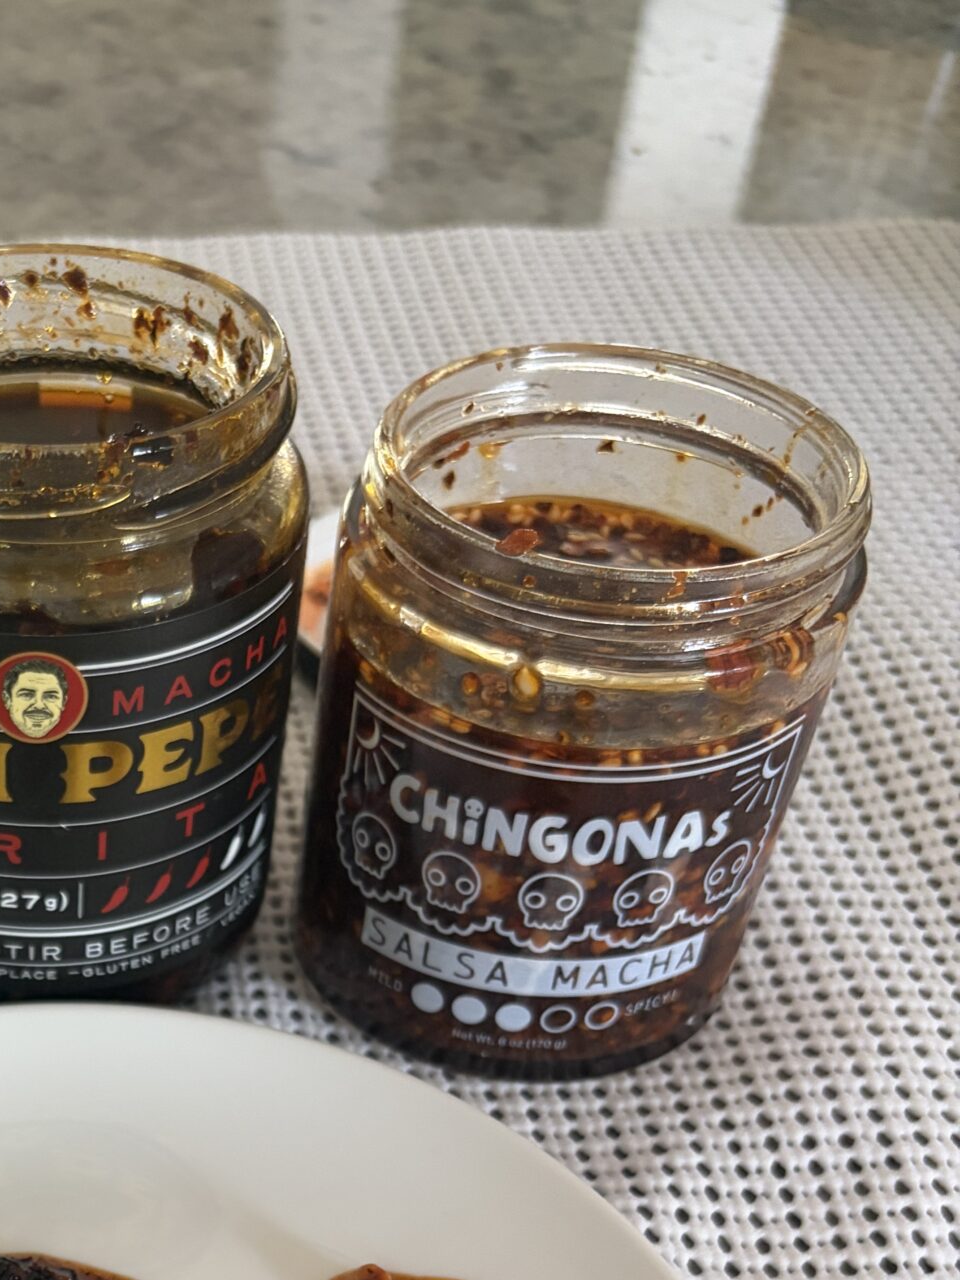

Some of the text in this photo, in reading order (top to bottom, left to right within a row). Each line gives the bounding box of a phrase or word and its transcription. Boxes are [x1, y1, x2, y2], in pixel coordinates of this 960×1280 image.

[112, 616, 288, 717] MACHA
[85, 905, 212, 959] BEFORE
[160, 935, 202, 959] FREE
[367, 916, 696, 990] SALSA MACHA
